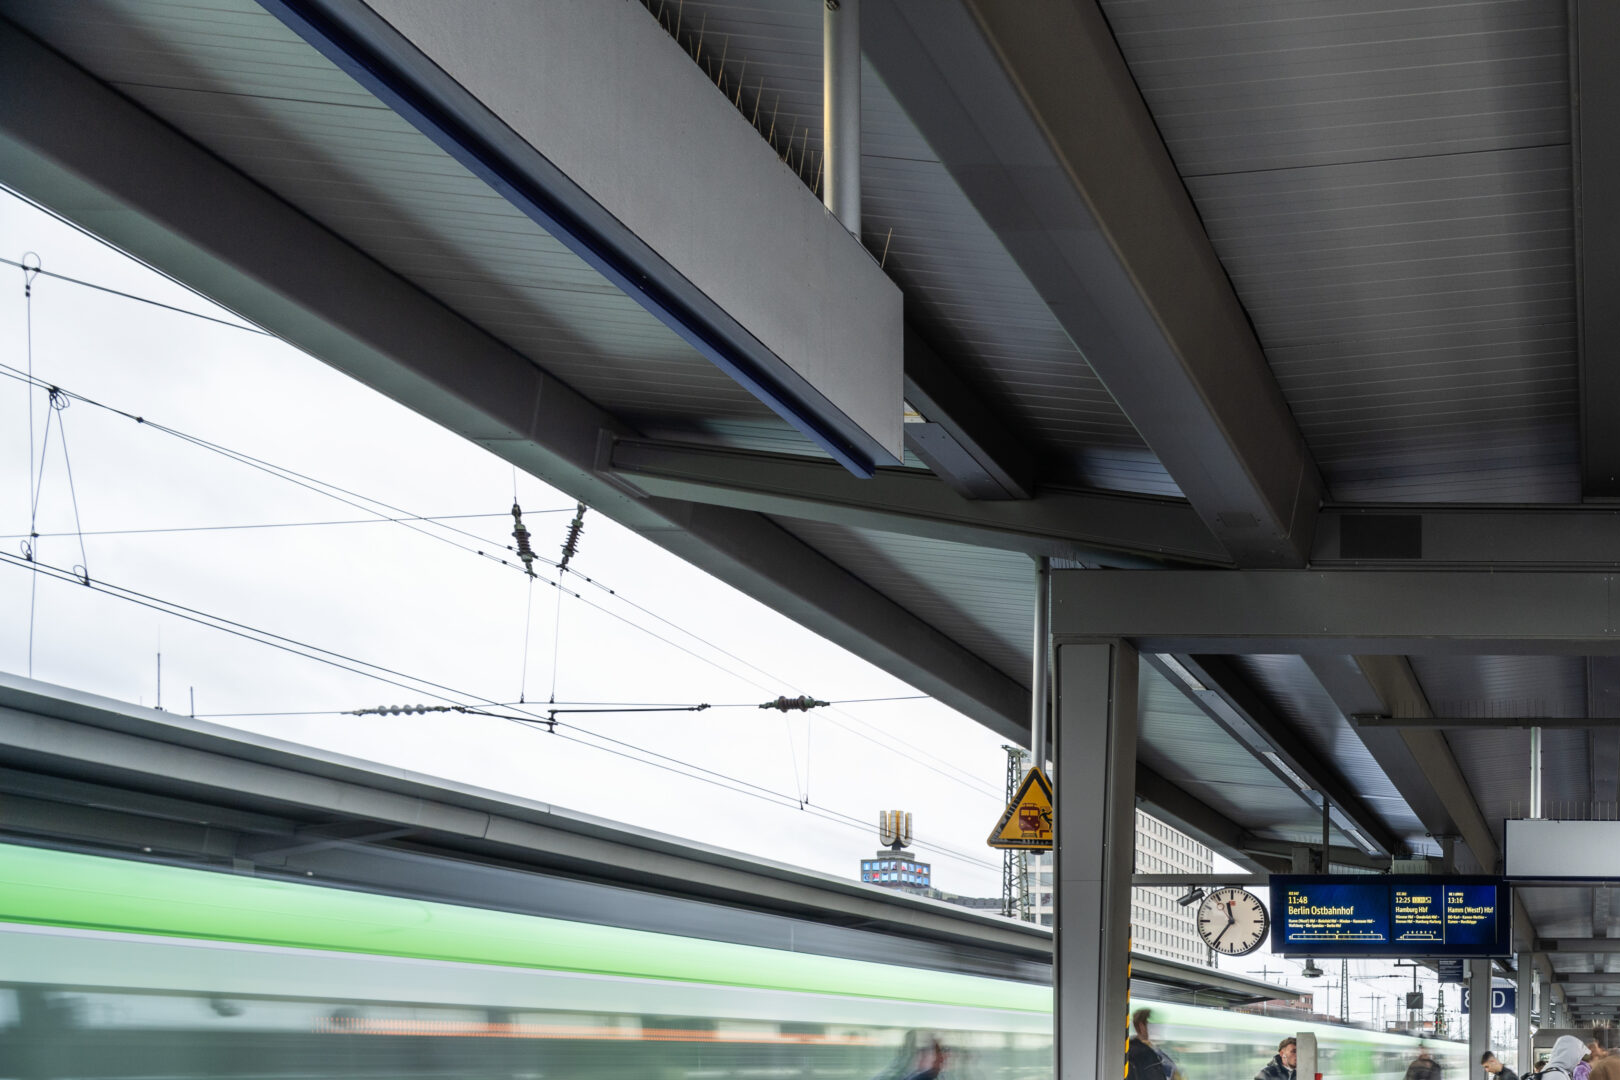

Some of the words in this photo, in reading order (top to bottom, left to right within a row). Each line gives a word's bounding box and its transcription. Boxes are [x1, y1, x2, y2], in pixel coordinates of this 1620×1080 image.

[1288, 896, 1308, 904] 11:48
[1288, 906, 1310, 915] Berlin
[1311, 906, 1354, 915] Ostbahnhof
[1395, 906, 1418, 914] Hamburg
[1464, 906, 1484, 914] (Westf)
[1492, 991, 1506, 1008] D
